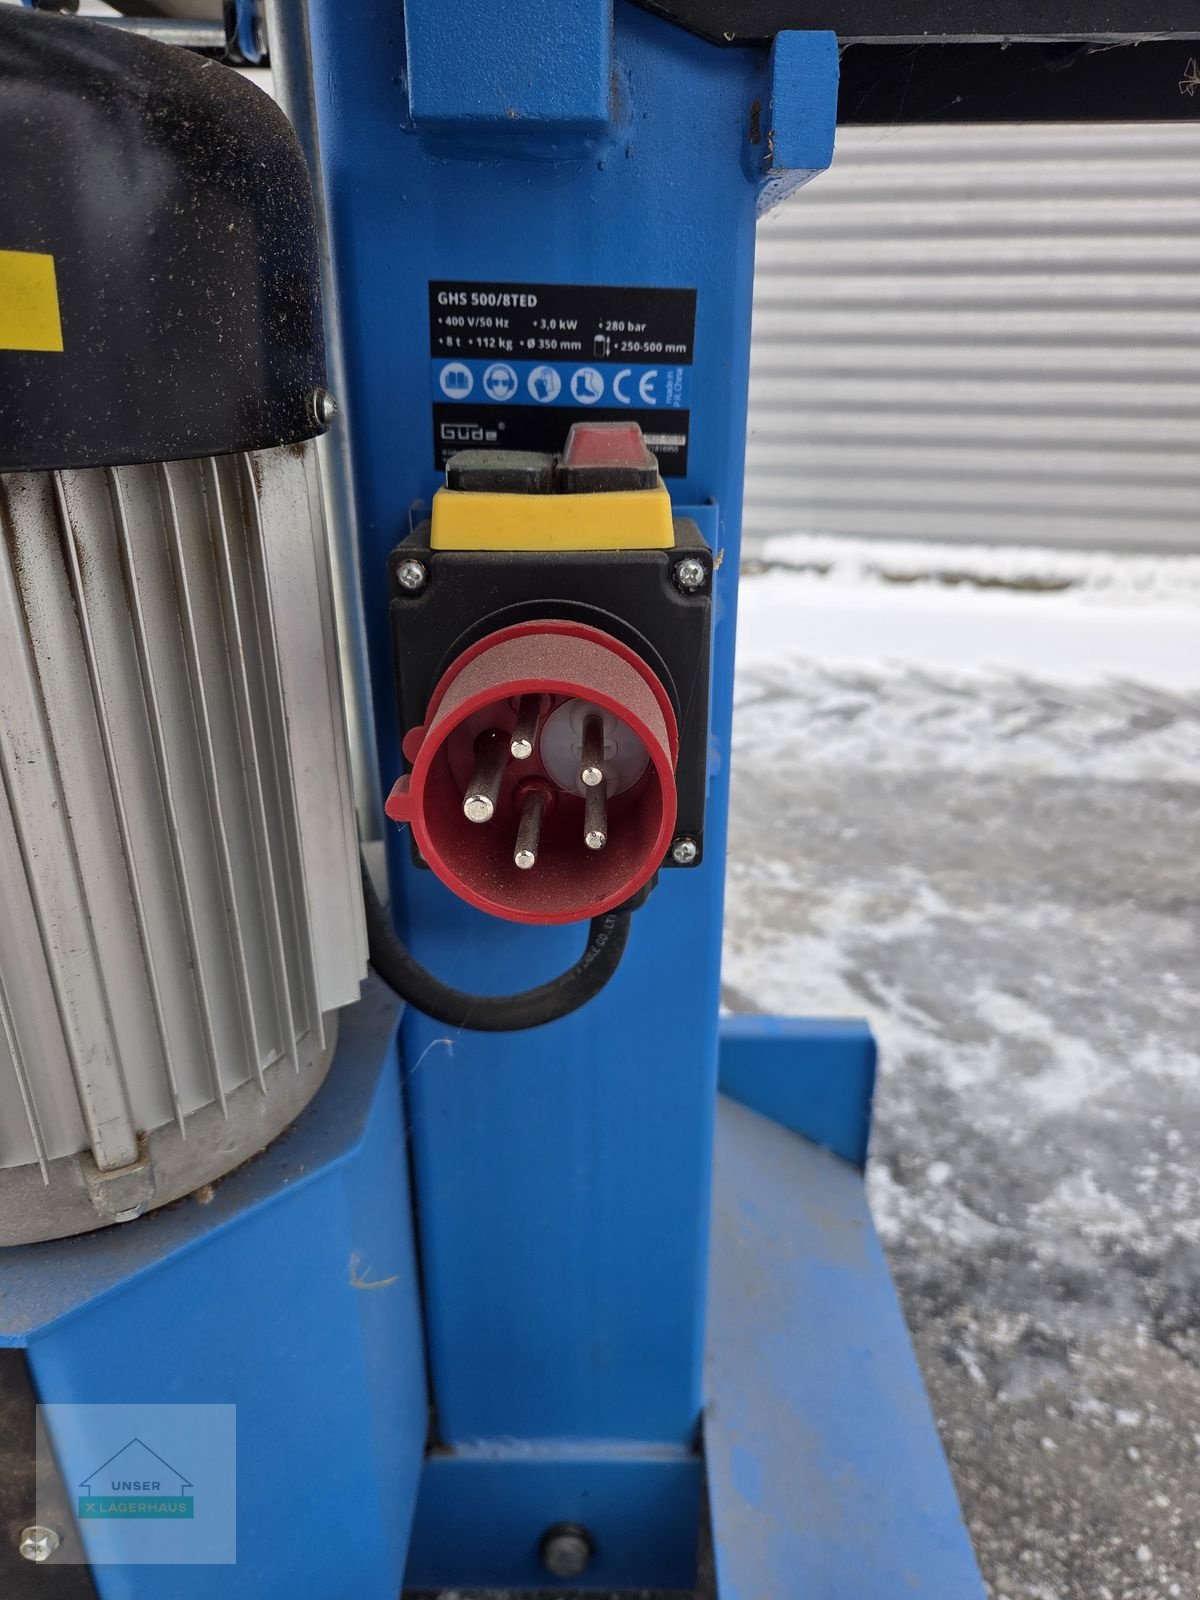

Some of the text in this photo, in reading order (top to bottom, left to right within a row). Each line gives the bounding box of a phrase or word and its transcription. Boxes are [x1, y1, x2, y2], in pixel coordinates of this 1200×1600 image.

[438, 292, 538, 308] GHS 500/8TED
[445, 316, 509, 329] 400 V/50 Hz
[539, 319, 578, 331] 3,0 kW
[605, 321, 647, 332] 280 bar
[446, 337, 461, 347] 8 t
[476, 338, 513, 351] 112 kg
[538, 339, 558, 350] 350
[560, 341, 582, 351] mm
[621, 342, 687, 354] 250-500 mm
[665, 380, 674, 404] made
